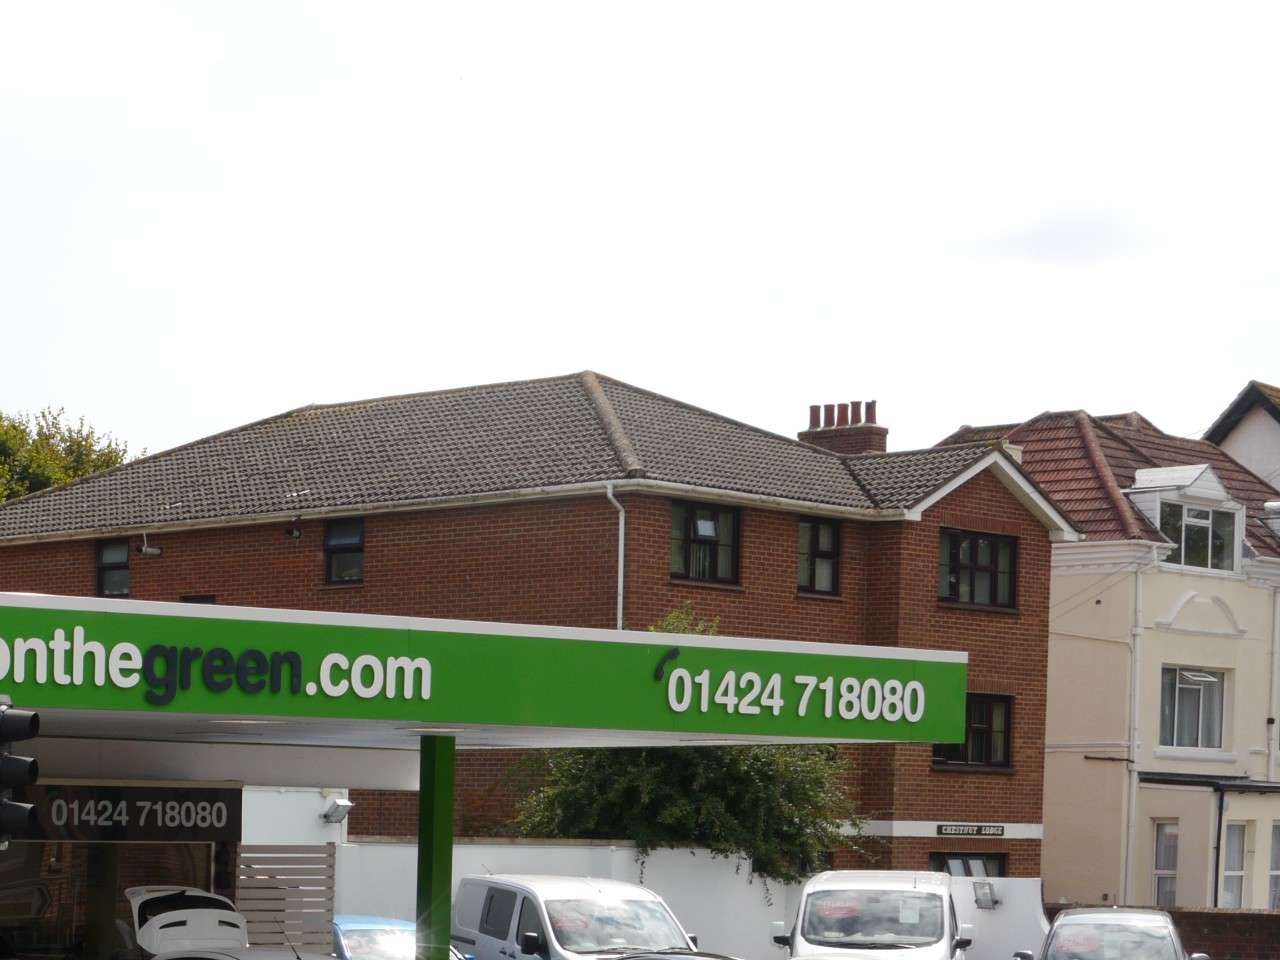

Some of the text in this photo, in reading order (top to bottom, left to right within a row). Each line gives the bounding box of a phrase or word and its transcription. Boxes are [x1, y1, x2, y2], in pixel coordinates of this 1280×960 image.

[668, 667, 926, 723] 01424 718080
[51, 799, 227, 828] 01424 718080
